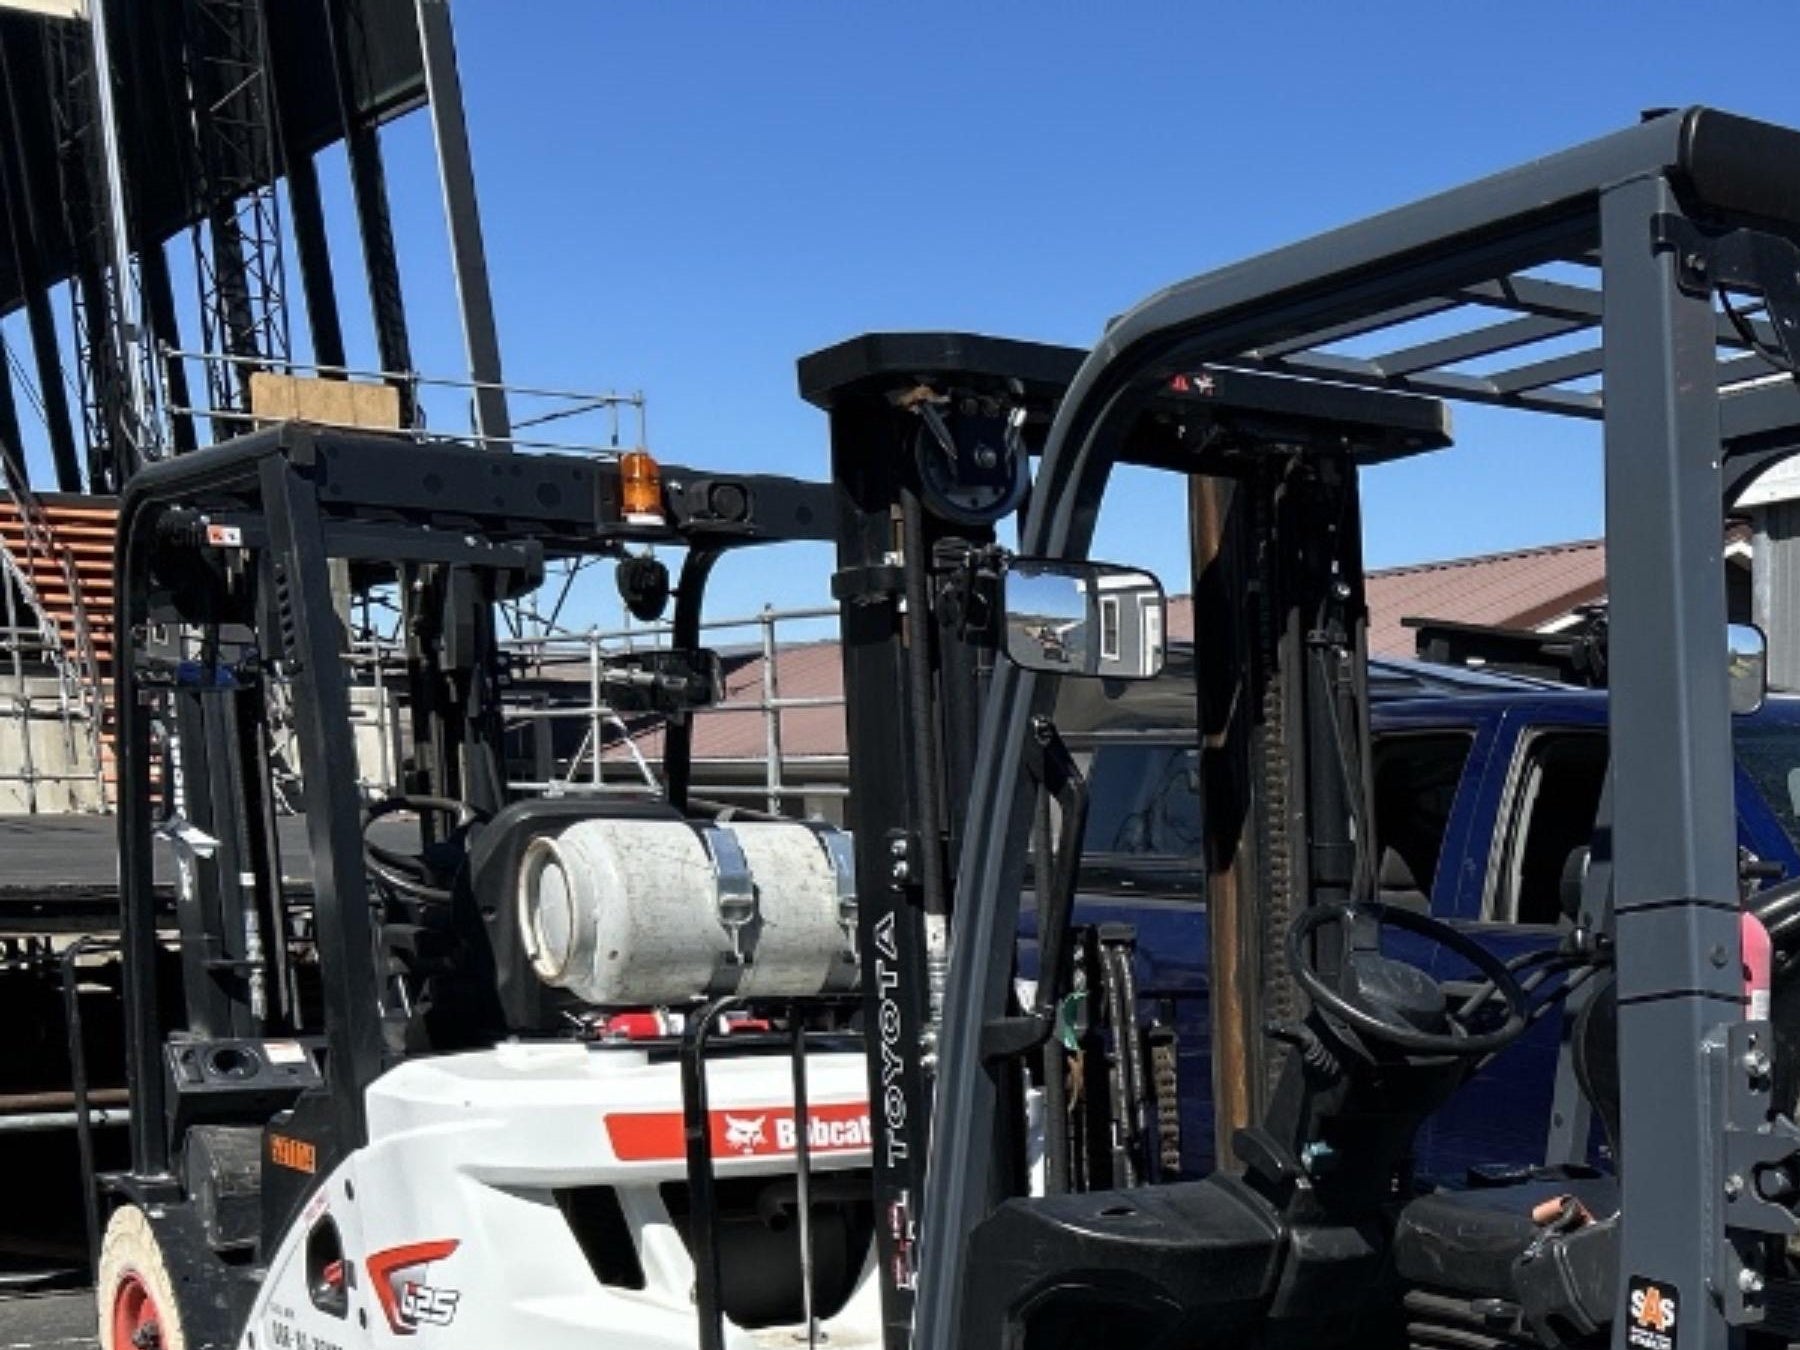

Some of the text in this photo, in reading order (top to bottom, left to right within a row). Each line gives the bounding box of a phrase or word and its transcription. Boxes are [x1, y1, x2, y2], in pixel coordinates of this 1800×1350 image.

[874, 911, 909, 1168] TOYOTA
[775, 1114, 872, 1150] Bbcat
[1630, 1286, 1676, 1333] SAS
